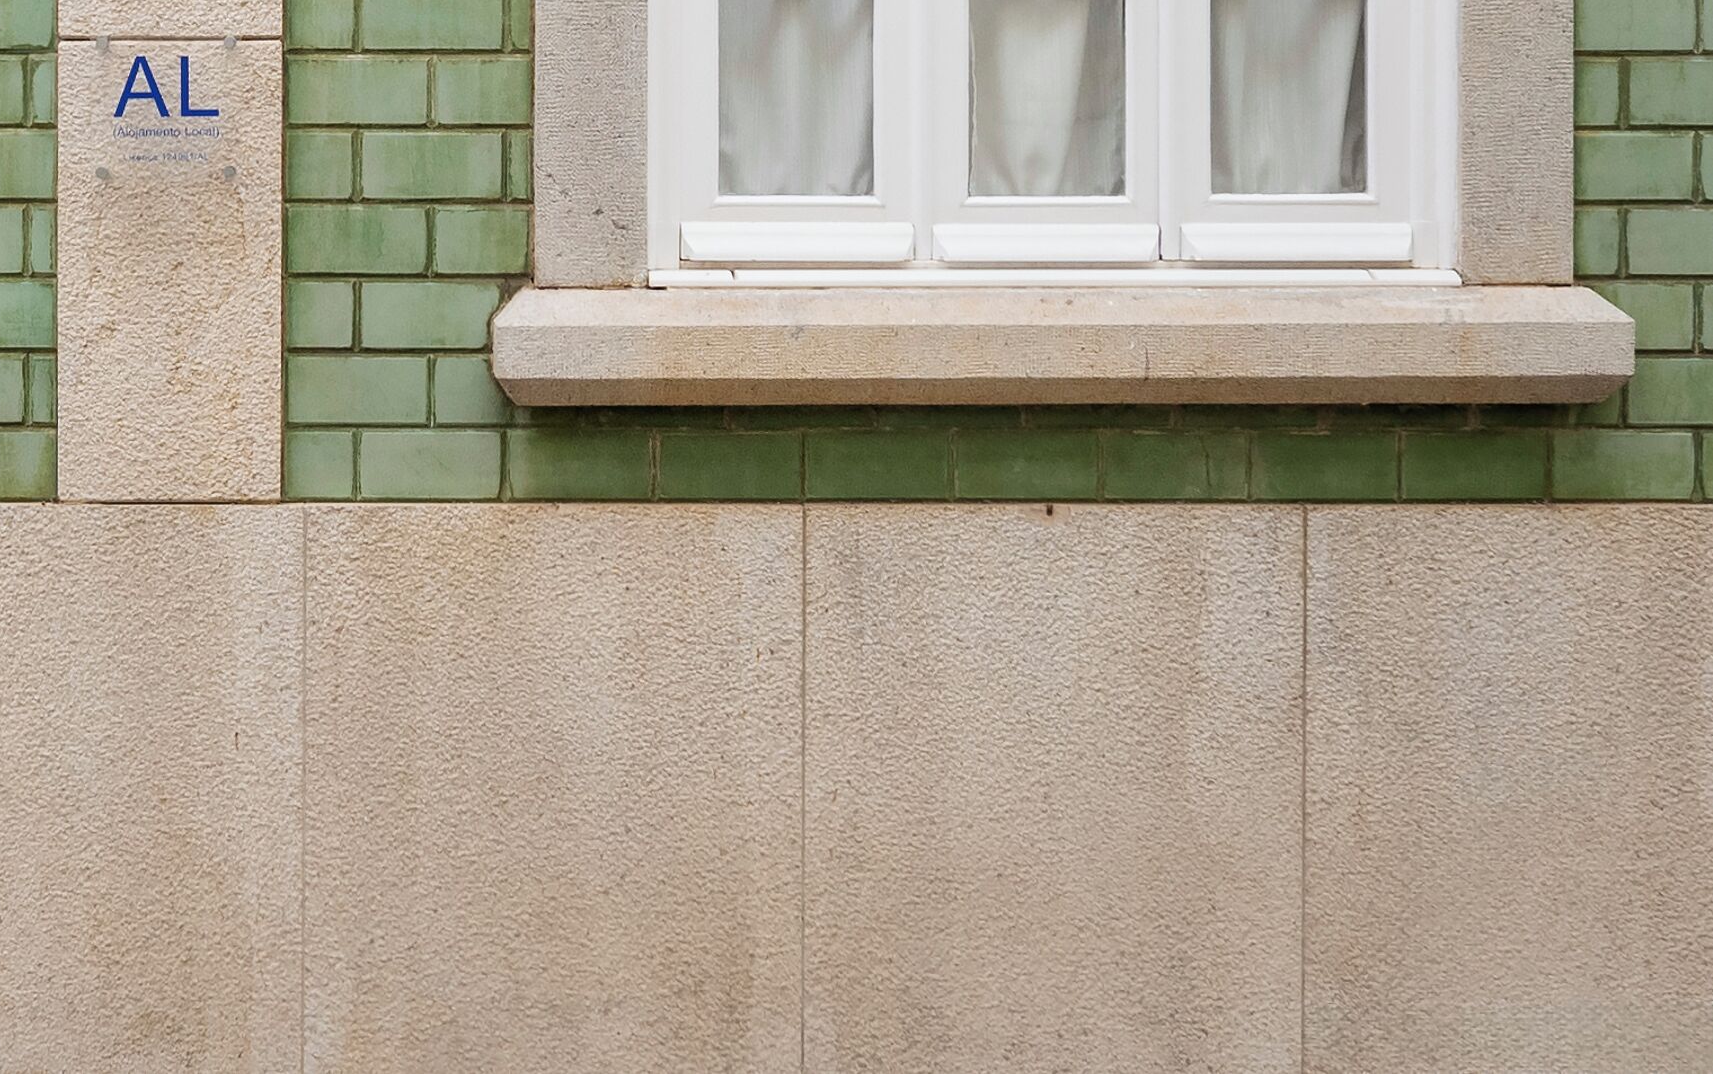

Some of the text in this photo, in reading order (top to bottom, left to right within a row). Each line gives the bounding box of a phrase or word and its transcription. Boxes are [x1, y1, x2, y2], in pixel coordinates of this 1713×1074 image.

[114, 56, 219, 117] AL
[113, 126, 220, 139] (Alojamento Local)
